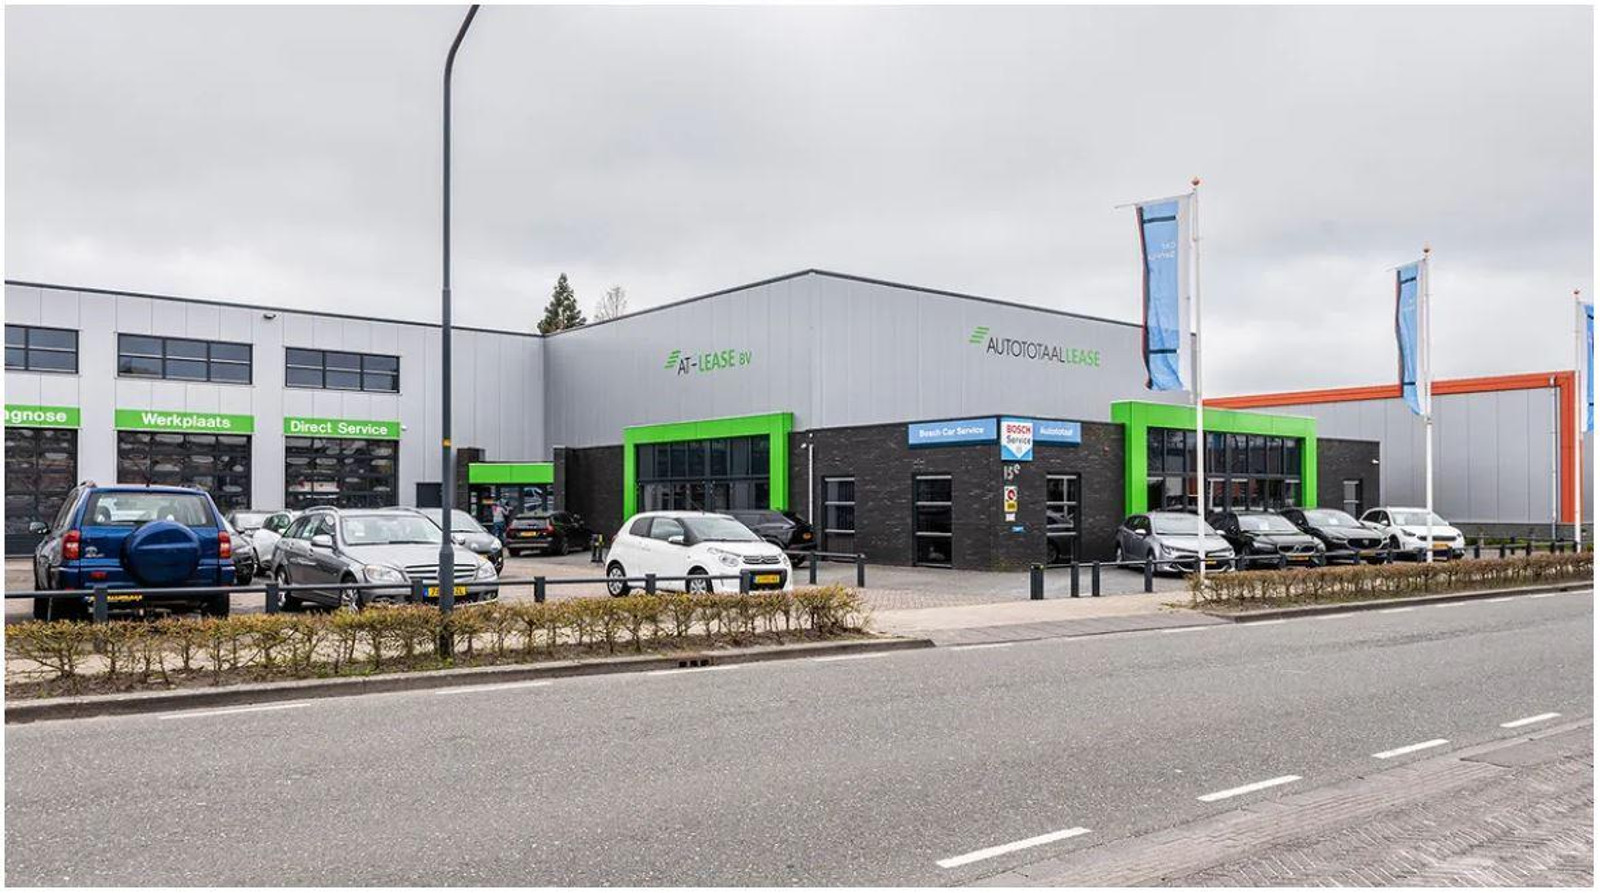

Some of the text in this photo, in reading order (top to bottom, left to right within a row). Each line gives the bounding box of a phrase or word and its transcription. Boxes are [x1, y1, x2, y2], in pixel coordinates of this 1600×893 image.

[739, 351, 752, 365] BV
[141, 412, 231, 428] Werkplaats
[290, 420, 388, 435] Direct Service
[919, 425, 984, 438] Bosch Car Service
[1006, 424, 1031, 435] BOSCH
[1006, 434, 1031, 445] Service
